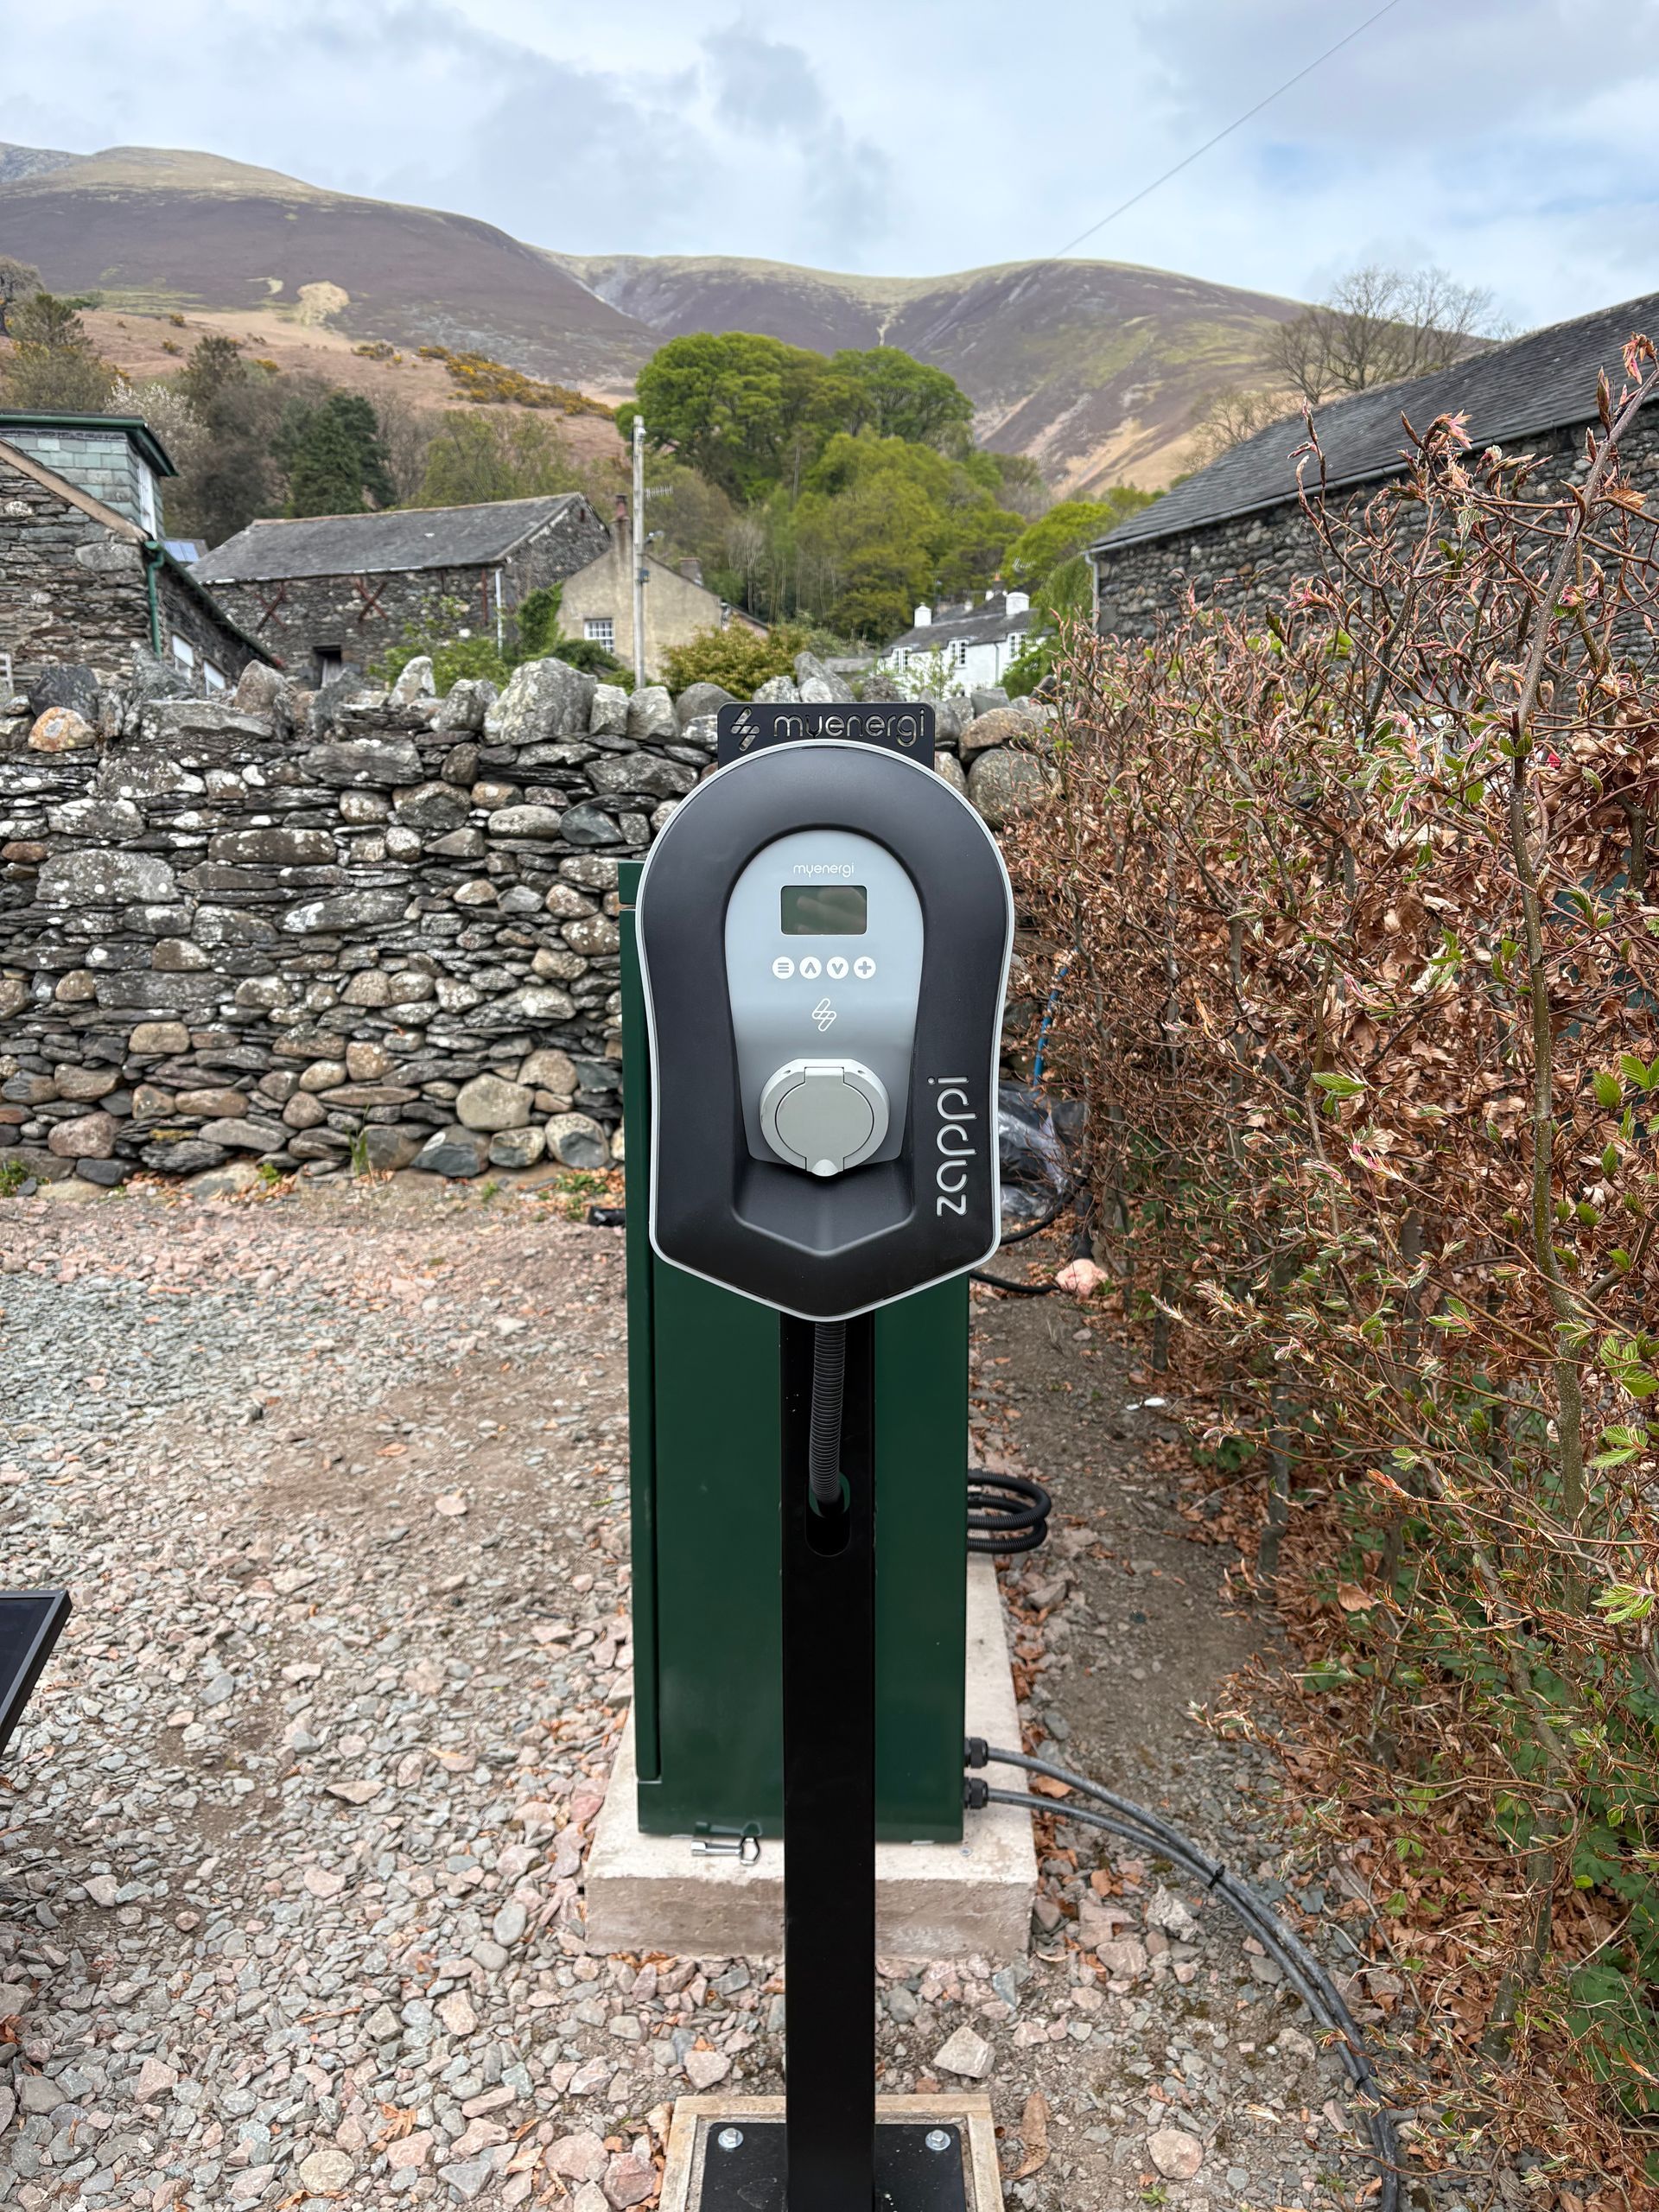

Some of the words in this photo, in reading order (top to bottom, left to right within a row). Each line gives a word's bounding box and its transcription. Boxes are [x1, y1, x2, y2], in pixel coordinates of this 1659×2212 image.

[773, 709, 925, 747] myenergi
[793, 862, 855, 878] myenergi
[927, 1076, 977, 1217] zappi
